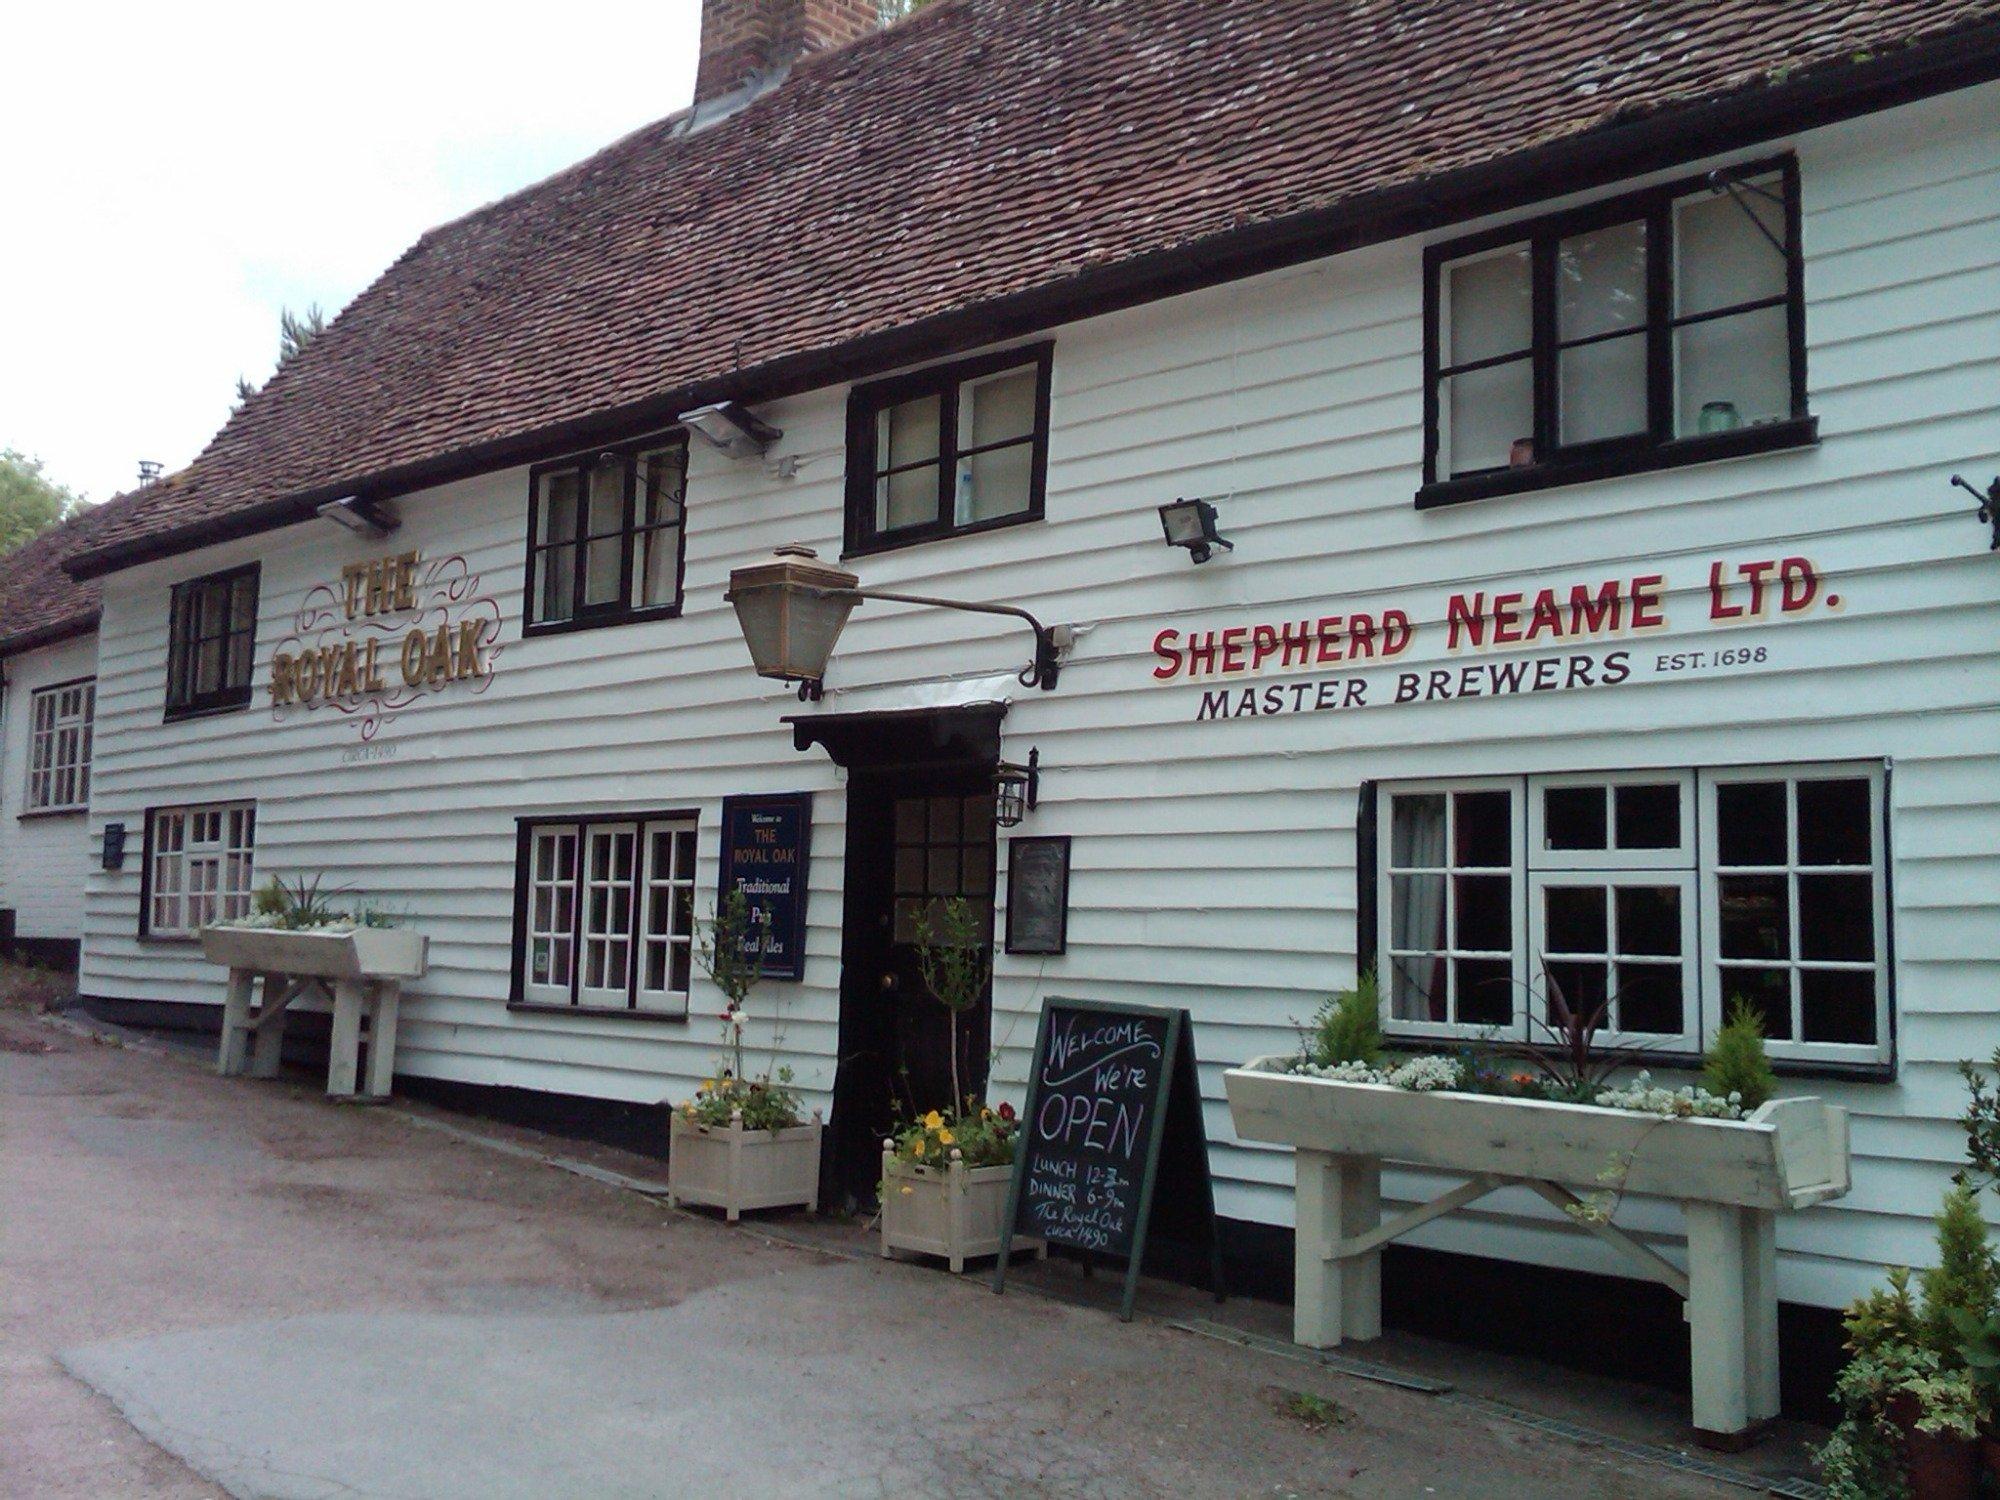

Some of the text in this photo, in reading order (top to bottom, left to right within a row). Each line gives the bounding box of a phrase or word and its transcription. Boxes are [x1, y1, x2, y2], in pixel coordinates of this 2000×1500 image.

[342, 550, 421, 620] THE
[1152, 556, 1840, 680] SHEPHERD NEAME LTD.
[270, 617, 488, 708] ROYAL OAK
[1196, 678, 1368, 721] MASTER
[1395, 652, 1631, 703] BREWERS
[755, 829, 777, 843] THE
[734, 848, 796, 864] ROYAL OAK
[736, 876, 791, 895] Traditional
[1049, 1011, 1151, 1070] WELCOME
[1094, 1063, 1147, 1094] We're
[1038, 1093, 1144, 1160] OPEN
[1033, 1153, 1077, 1178] LUNCH
[1029, 1178, 1077, 1205] DINNER
[1034, 1201, 1058, 1220] The
